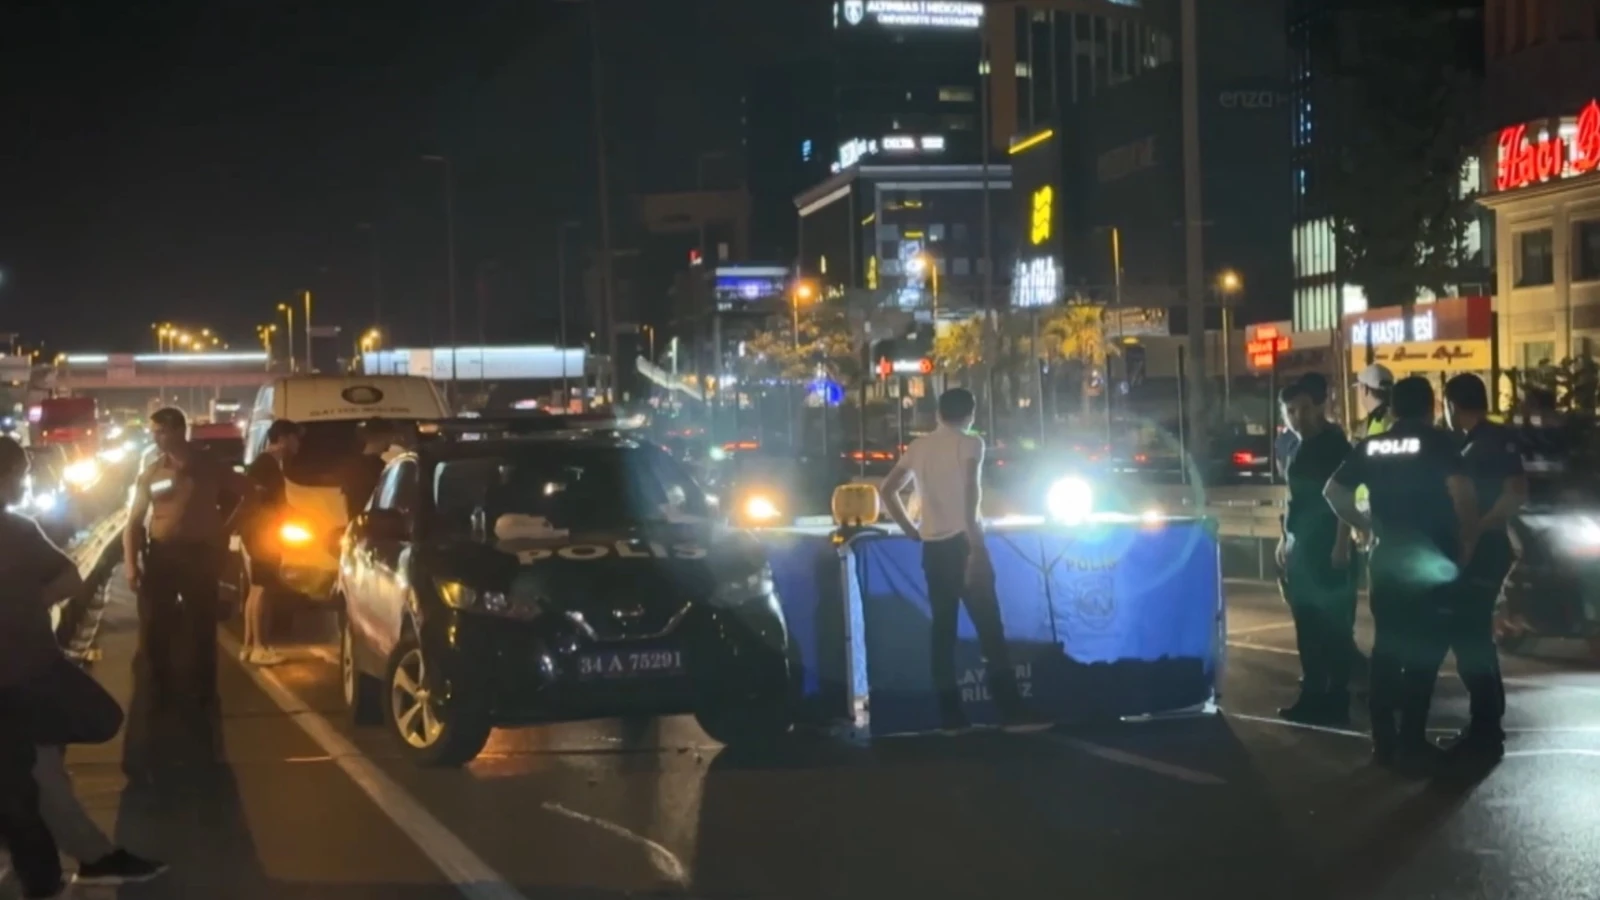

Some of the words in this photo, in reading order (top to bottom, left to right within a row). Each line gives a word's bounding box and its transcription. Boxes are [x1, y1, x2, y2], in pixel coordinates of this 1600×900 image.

[1219, 91, 1272, 108] enza
[1371, 309, 1434, 344] HASTAESİ
[580, 656, 602, 674] 34
[608, 654, 624, 673] A
[628, 651, 681, 671] 75291
